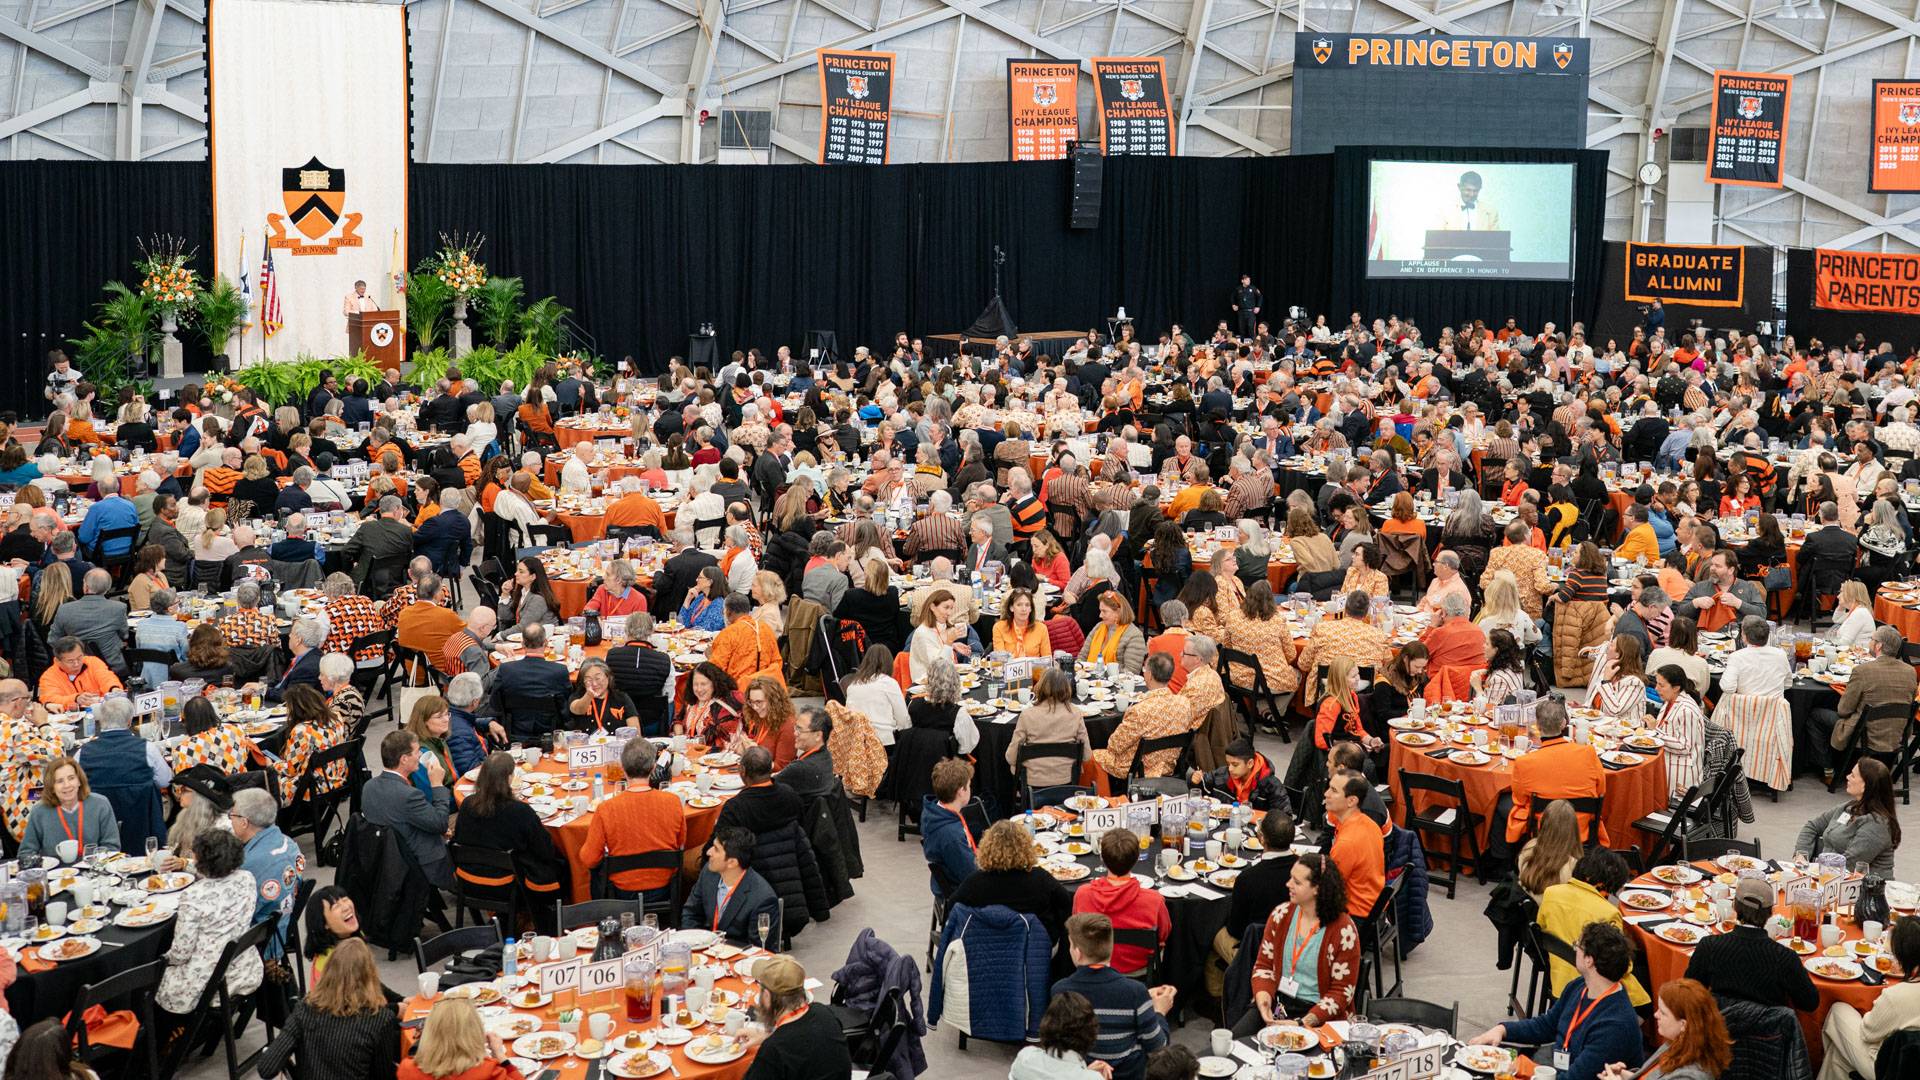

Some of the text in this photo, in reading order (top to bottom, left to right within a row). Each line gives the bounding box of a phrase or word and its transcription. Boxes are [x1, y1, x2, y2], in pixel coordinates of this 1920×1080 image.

[1349, 39, 1537, 68] PRINCETON
[825, 57, 888, 70] PRINCETON
[1099, 65, 1158, 73] PRINCETON
[1014, 67, 1075, 77] PRINCETON
[1721, 79, 1784, 92] PRINCETON
[1880, 88, 1920, 96] PRINCE
[836, 98, 881, 109] IVY LEAGUE
[829, 106, 888, 121] CHAMPIONS
[1106, 109, 1167, 118] CHAMPIONS
[851, 121, 865, 129] 1976
[1014, 117, 1077, 126] CHAMPIONS
[1740, 120, 1773, 129] LEAGUE
[1717, 127, 1780, 139] CHAMPIONS
[849, 146, 864, 154] 1999
[1636, 254, 1733, 270] GRADUATE
[1819, 255, 1918, 281] PRINCETO
[1647, 275, 1722, 292] ALUMNI
[1828, 281, 1920, 308] PARENTS
[310, 516, 324, 524] '72
[1220, 530, 1231, 538] '81
[1010, 666, 1023, 677] '86
[140, 697, 158, 710] '82
[576, 751, 597, 764] '85
[1167, 802, 1182, 814] '01
[1093, 815, 1115, 828] '03
[549, 966, 576, 985] '07
[588, 966, 615, 985] '06
[1409, 1053, 1433, 1073] '18
